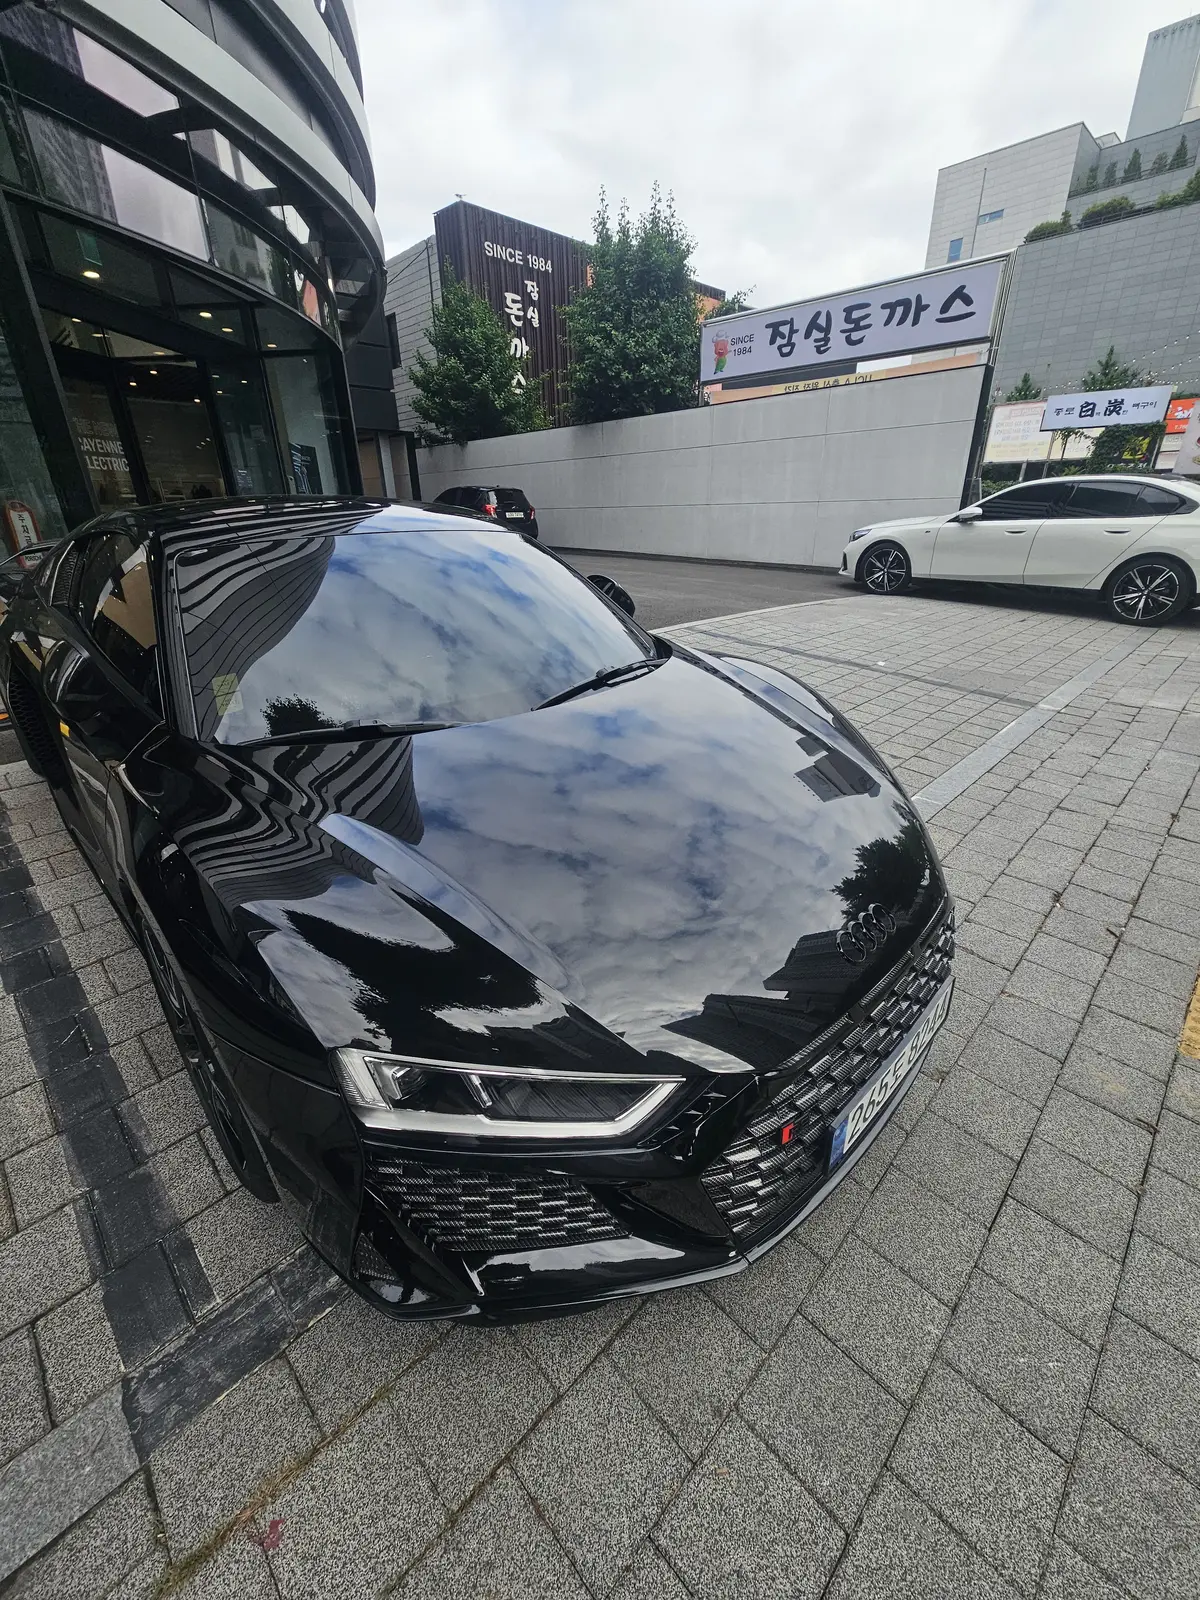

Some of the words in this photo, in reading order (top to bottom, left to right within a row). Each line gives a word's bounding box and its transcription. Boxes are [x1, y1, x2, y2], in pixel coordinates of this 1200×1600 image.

[484, 241, 524, 265] SINCE
[526, 253, 553, 274] 1984
[765, 284, 976, 358] 잠실돈까스
[730, 333, 755, 346] SINCE
[732, 346, 753, 357] 1984
[1054, 407, 1075, 417] 종로
[85, 455, 130, 471] LECTRIC
[907, 990, 950, 1066] 8244
